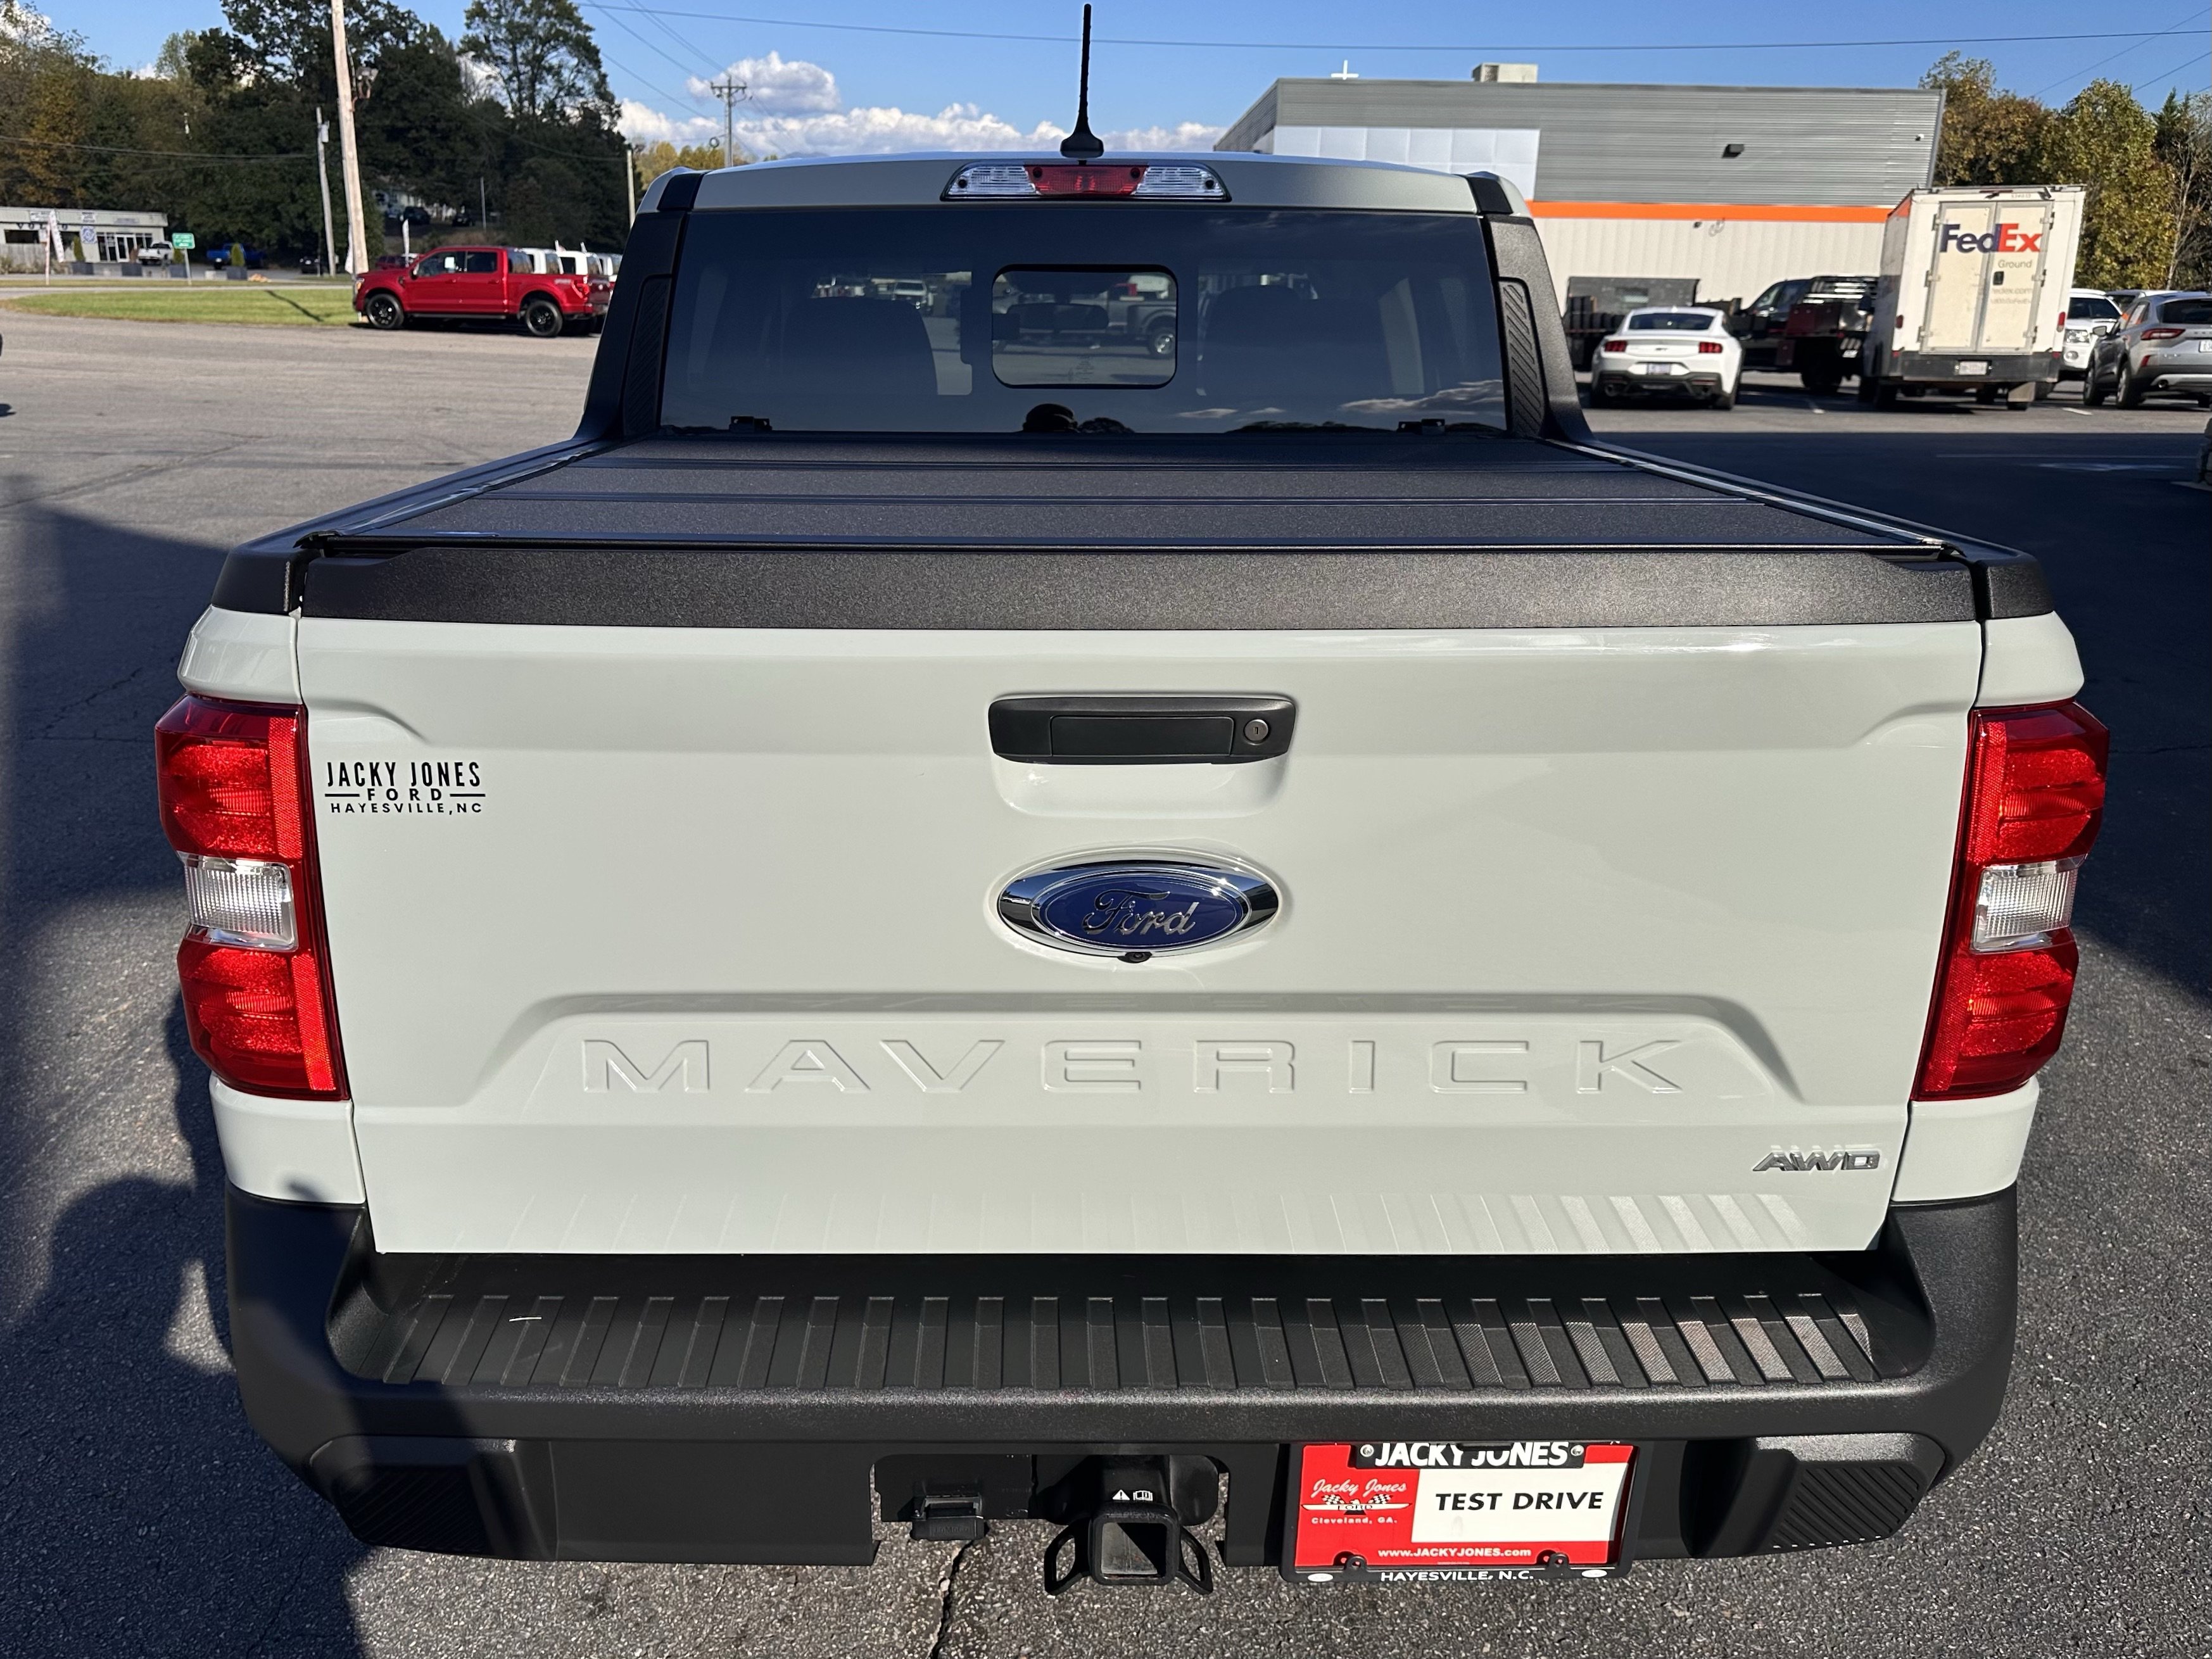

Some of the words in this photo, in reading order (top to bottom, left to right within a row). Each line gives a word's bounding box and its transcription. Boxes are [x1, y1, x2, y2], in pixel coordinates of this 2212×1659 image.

[1940, 223, 2043, 253] FedEx
[1997, 259, 2033, 268] Ground
[327, 762, 396, 787] JACKY
[411, 762, 481, 787] JONES
[367, 788, 442, 801] FORD
[1081, 889, 1199, 935] Ford
[582, 1040, 1683, 1094] MAVERICK
[1752, 1151, 1880, 1171] AWD
[1375, 1442, 1463, 1467] JACKY
[1471, 1441, 1569, 1467] JONES
[1310, 1478, 1359, 1499] Jacky
[1362, 1478, 1407, 1498] Jones
[1436, 1492, 1503, 1511] TEST
[1513, 1492, 1604, 1510] DRIVE
[1311, 1517, 1373, 1525] Cleveland,
[1378, 1548, 1532, 1558] www.JACKYJONES.com
[1381, 1571, 1493, 1582] HAYESVILLE,
[1498, 1570, 1534, 1580] N.C.
